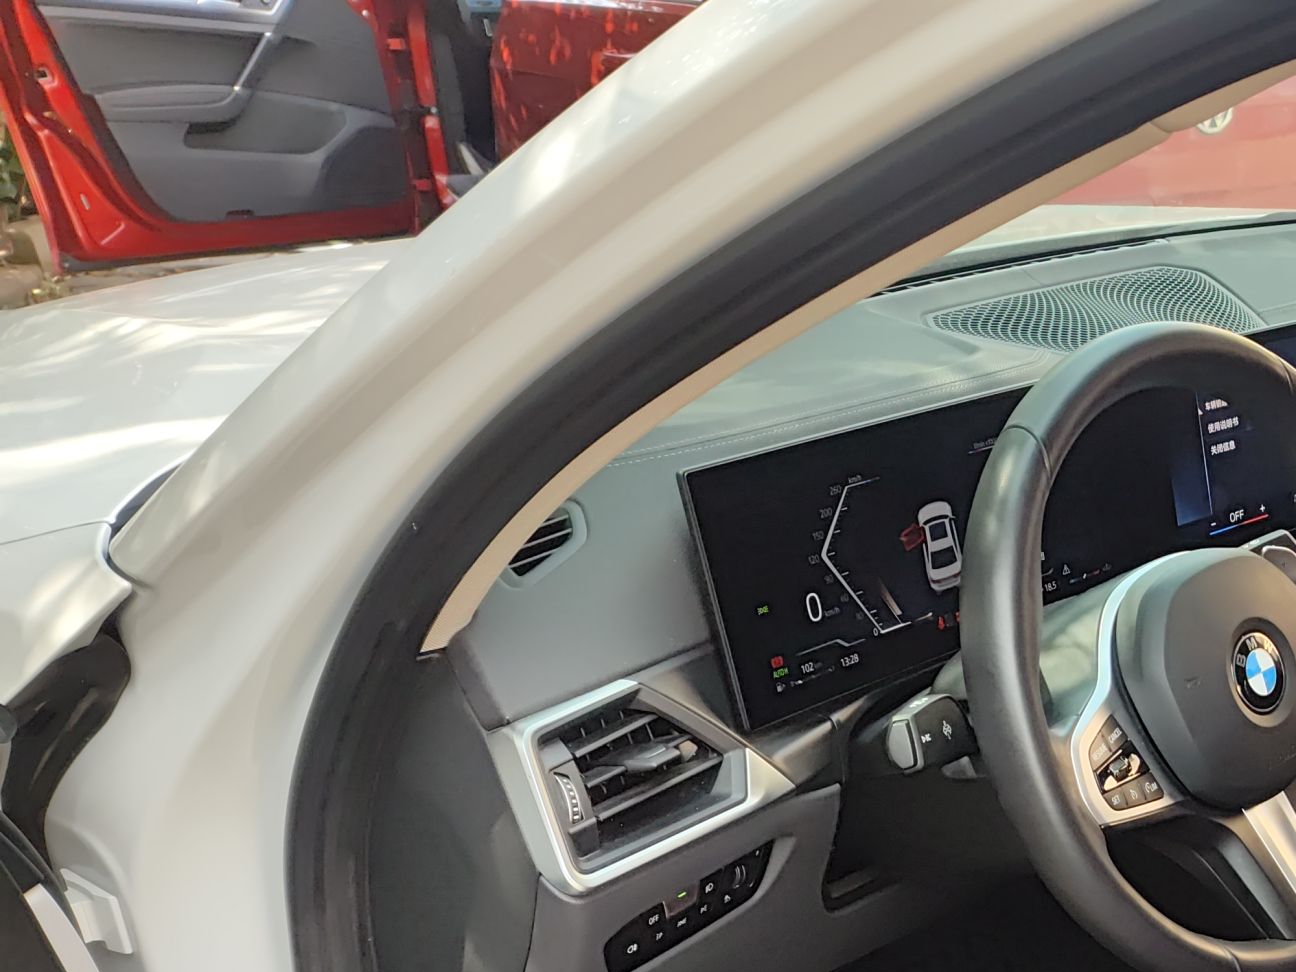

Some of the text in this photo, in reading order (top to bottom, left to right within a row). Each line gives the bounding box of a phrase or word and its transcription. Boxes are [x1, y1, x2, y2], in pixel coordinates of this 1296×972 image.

[819, 507, 833, 518] 200
[1229, 509, 1244, 523] OFF
[806, 592, 822, 622] 0
[873, 627, 879, 637] 0
[1236, 635, 1280, 668] BMW
[840, 653, 860, 667] 13:28
[801, 662, 815, 674] 102
[648, 914, 660, 926] OFF
